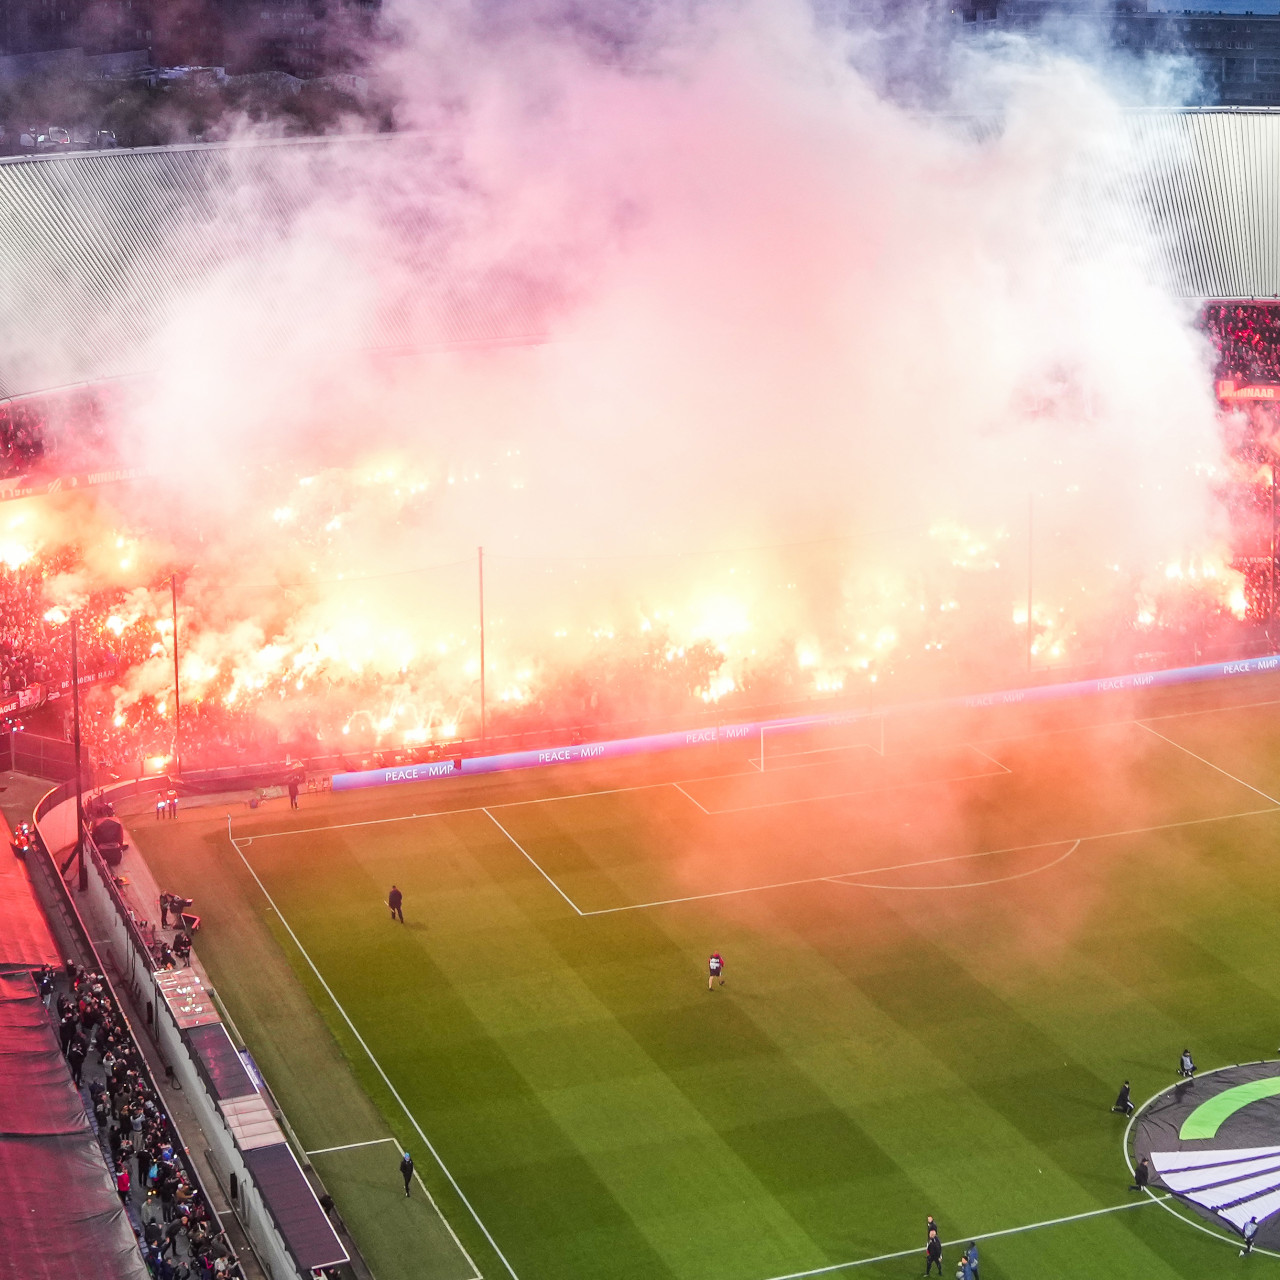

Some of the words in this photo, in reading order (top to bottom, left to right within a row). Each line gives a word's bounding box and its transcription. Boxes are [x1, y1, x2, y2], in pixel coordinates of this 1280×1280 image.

[1223, 662, 1250, 675] PEACE
[1097, 678, 1125, 691] PEACE
[686, 729, 717, 744] PEACE
[538, 750, 571, 763] PEACE
[385, 768, 419, 782] PEACE
